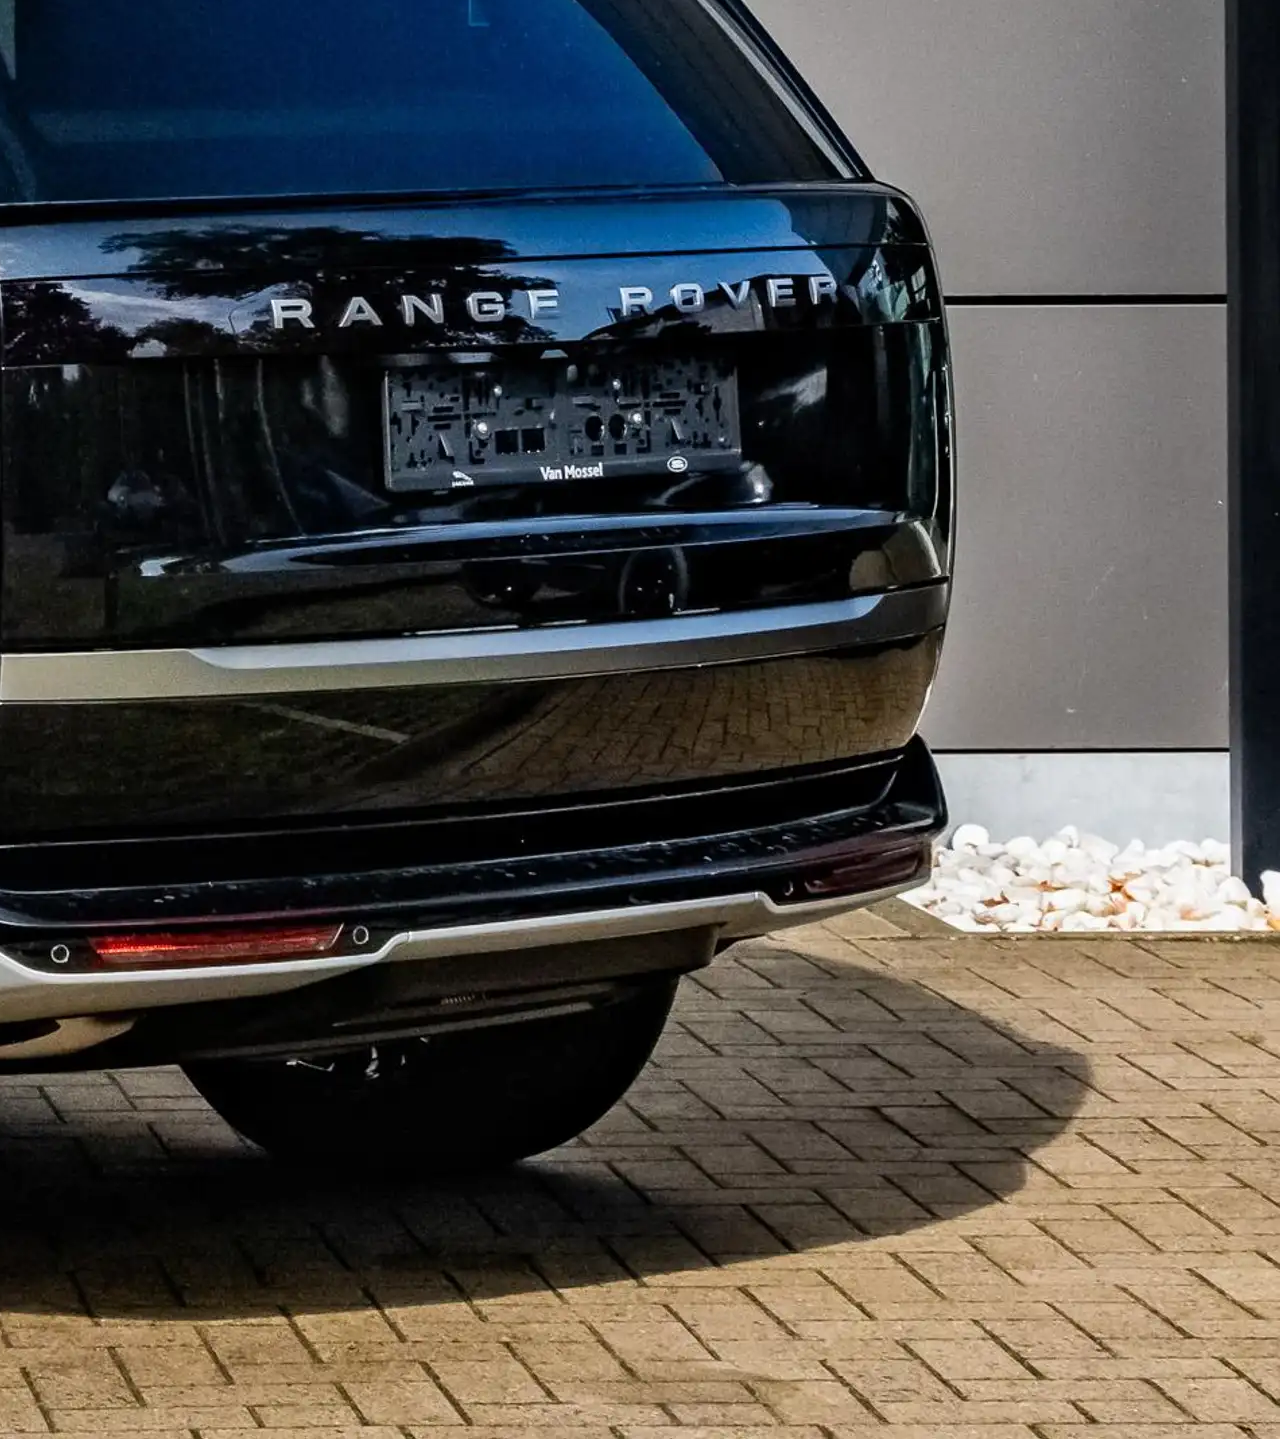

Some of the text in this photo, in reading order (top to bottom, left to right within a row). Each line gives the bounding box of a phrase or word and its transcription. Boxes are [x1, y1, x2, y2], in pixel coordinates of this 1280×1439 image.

[270, 275, 838, 330] RANGE ROVER
[540, 462, 604, 481] Van Mossel
